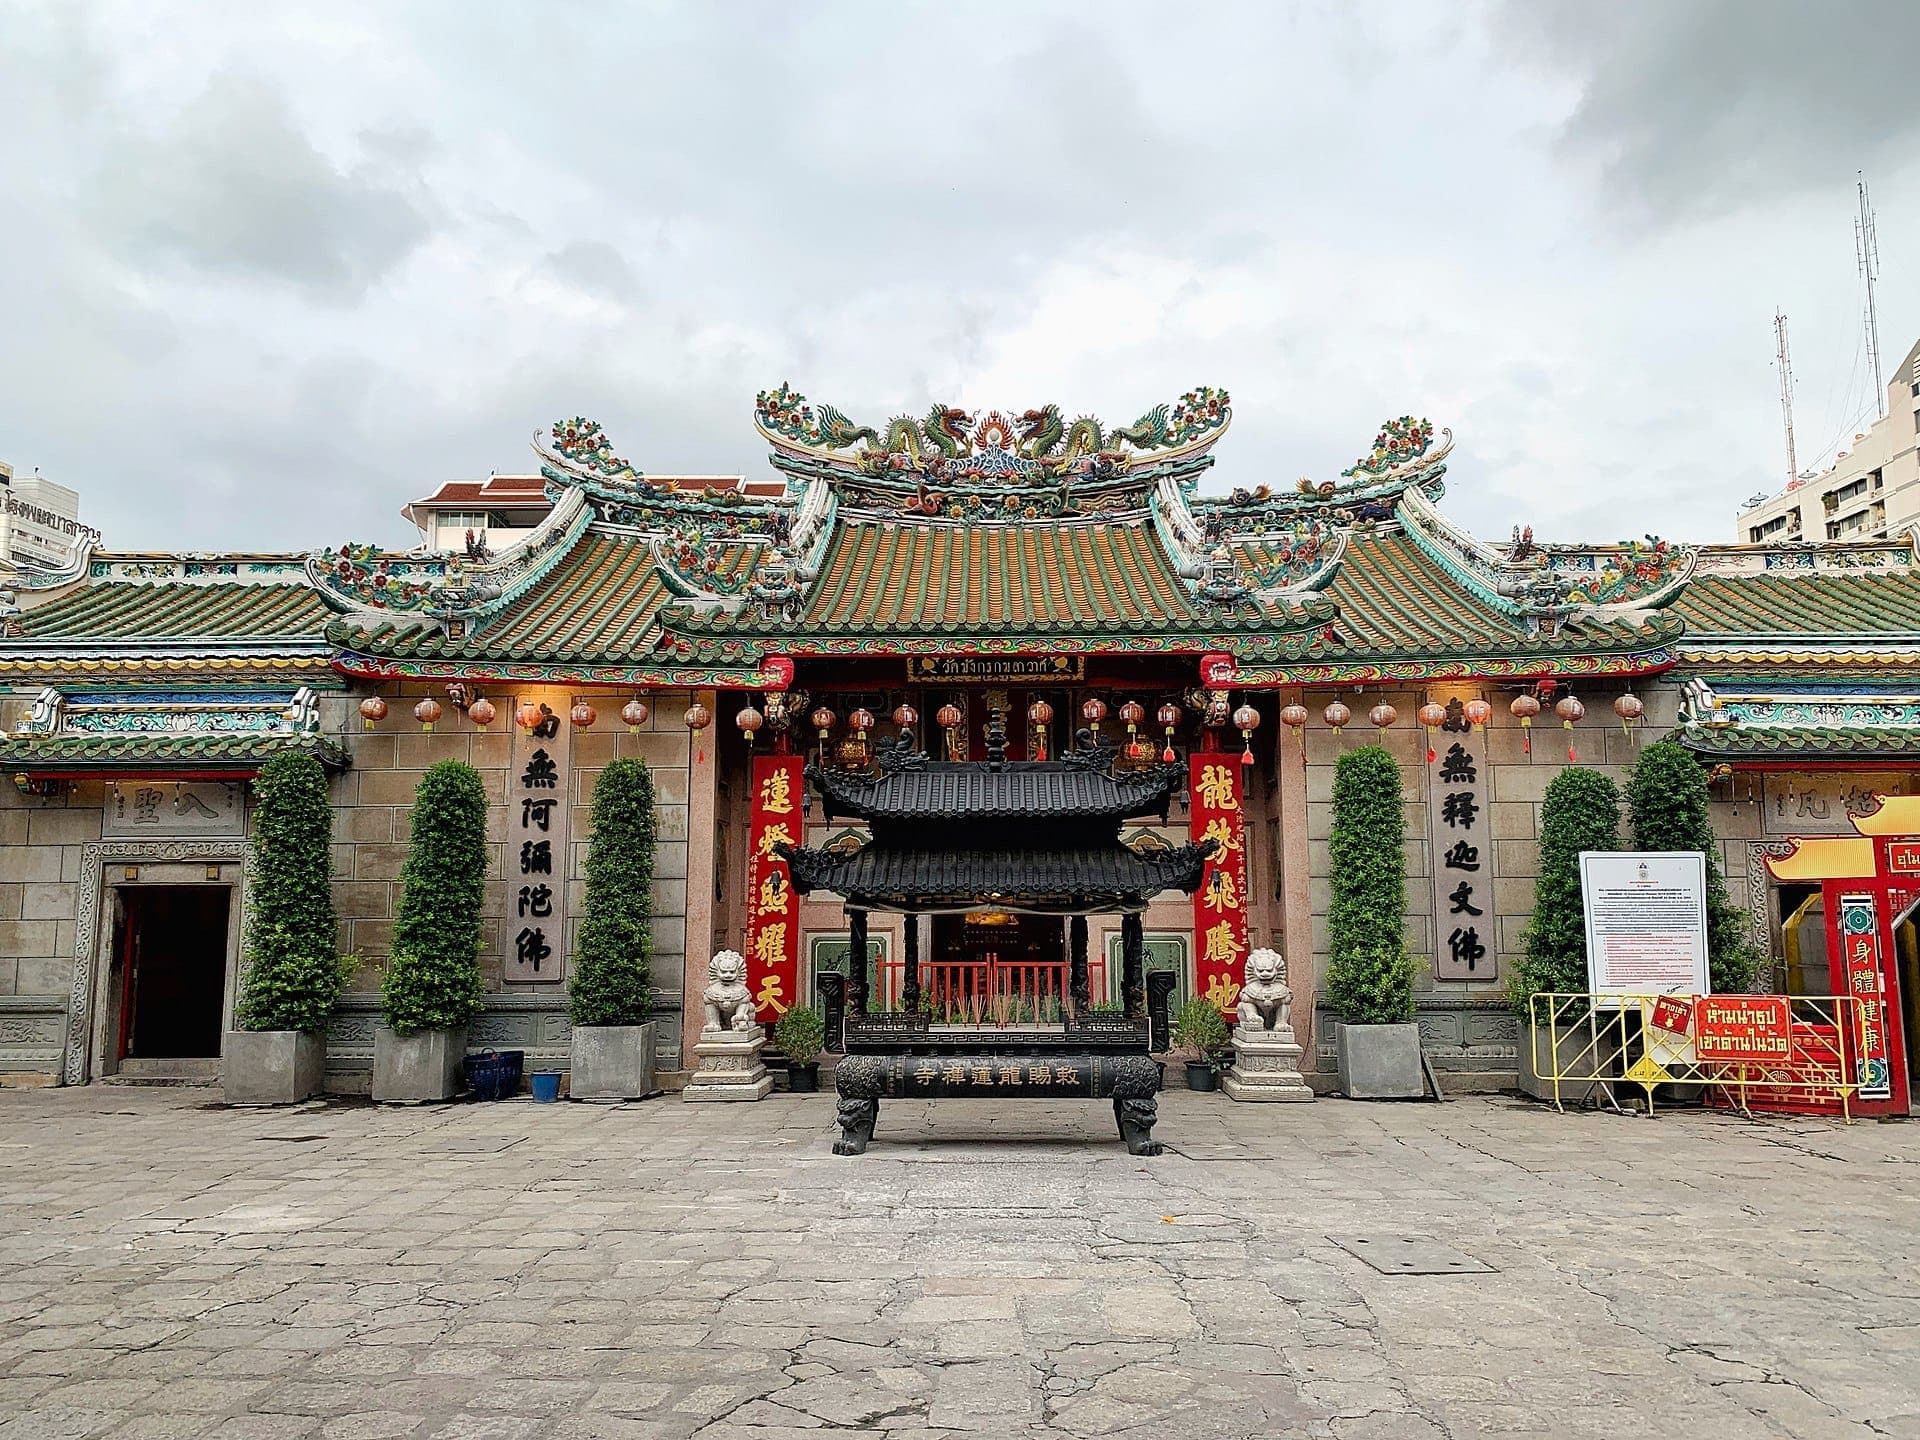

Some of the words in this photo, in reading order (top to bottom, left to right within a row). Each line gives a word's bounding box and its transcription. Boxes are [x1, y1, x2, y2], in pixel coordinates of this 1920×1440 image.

[1852, 940, 1880, 1052] 身體健康
[1706, 1001, 1776, 1031] ห้ามนำธูป
[1699, 1028, 1787, 1052] เข้าด้านในวัด
